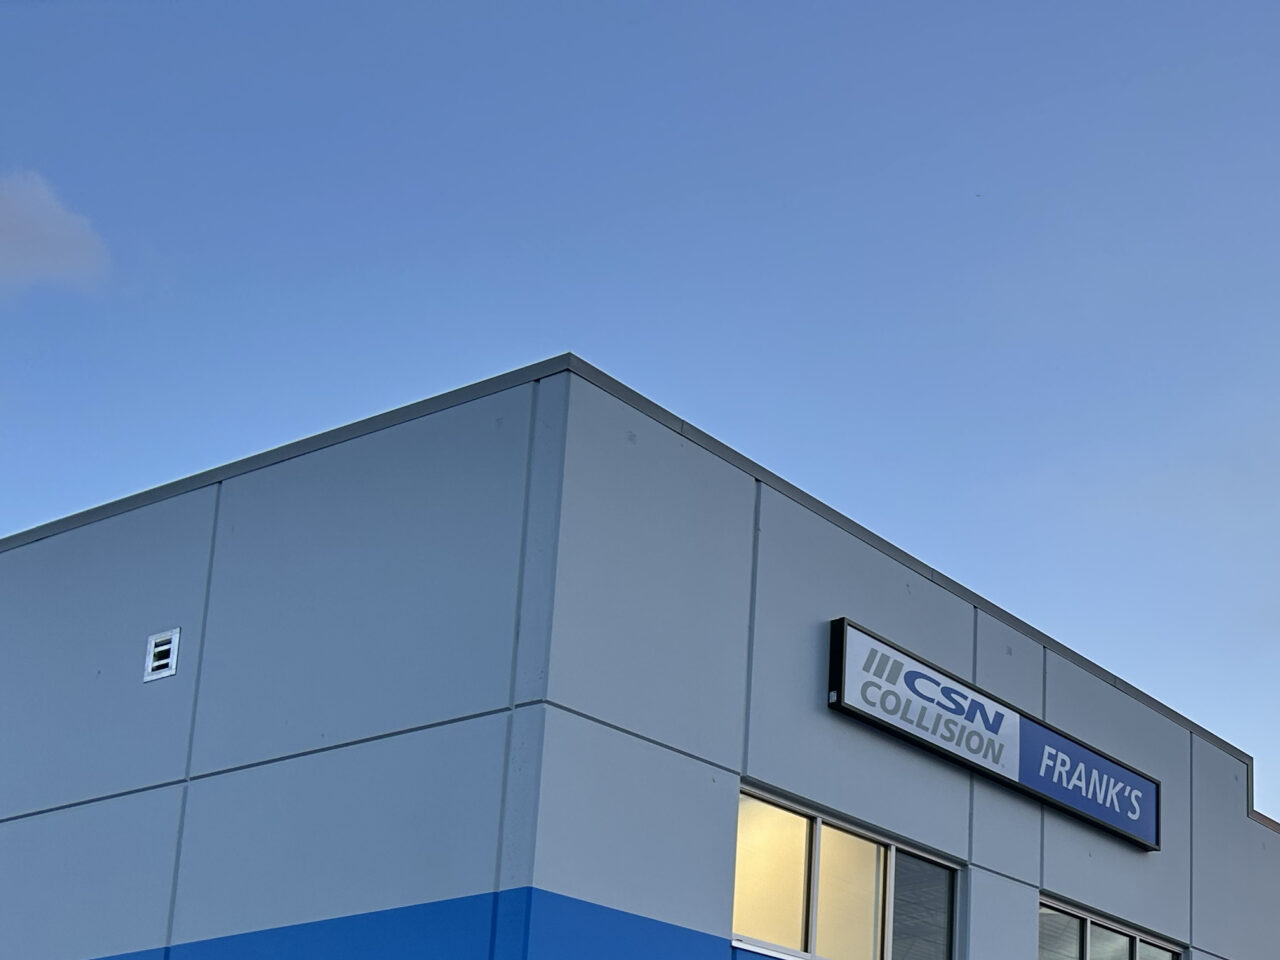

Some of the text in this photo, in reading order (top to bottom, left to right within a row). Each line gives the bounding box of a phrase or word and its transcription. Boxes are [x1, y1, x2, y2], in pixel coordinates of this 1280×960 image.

[860, 680, 1004, 765] COLLISION
[904, 670, 1004, 735] CSN
[1039, 745, 1142, 820] FRANK'S
